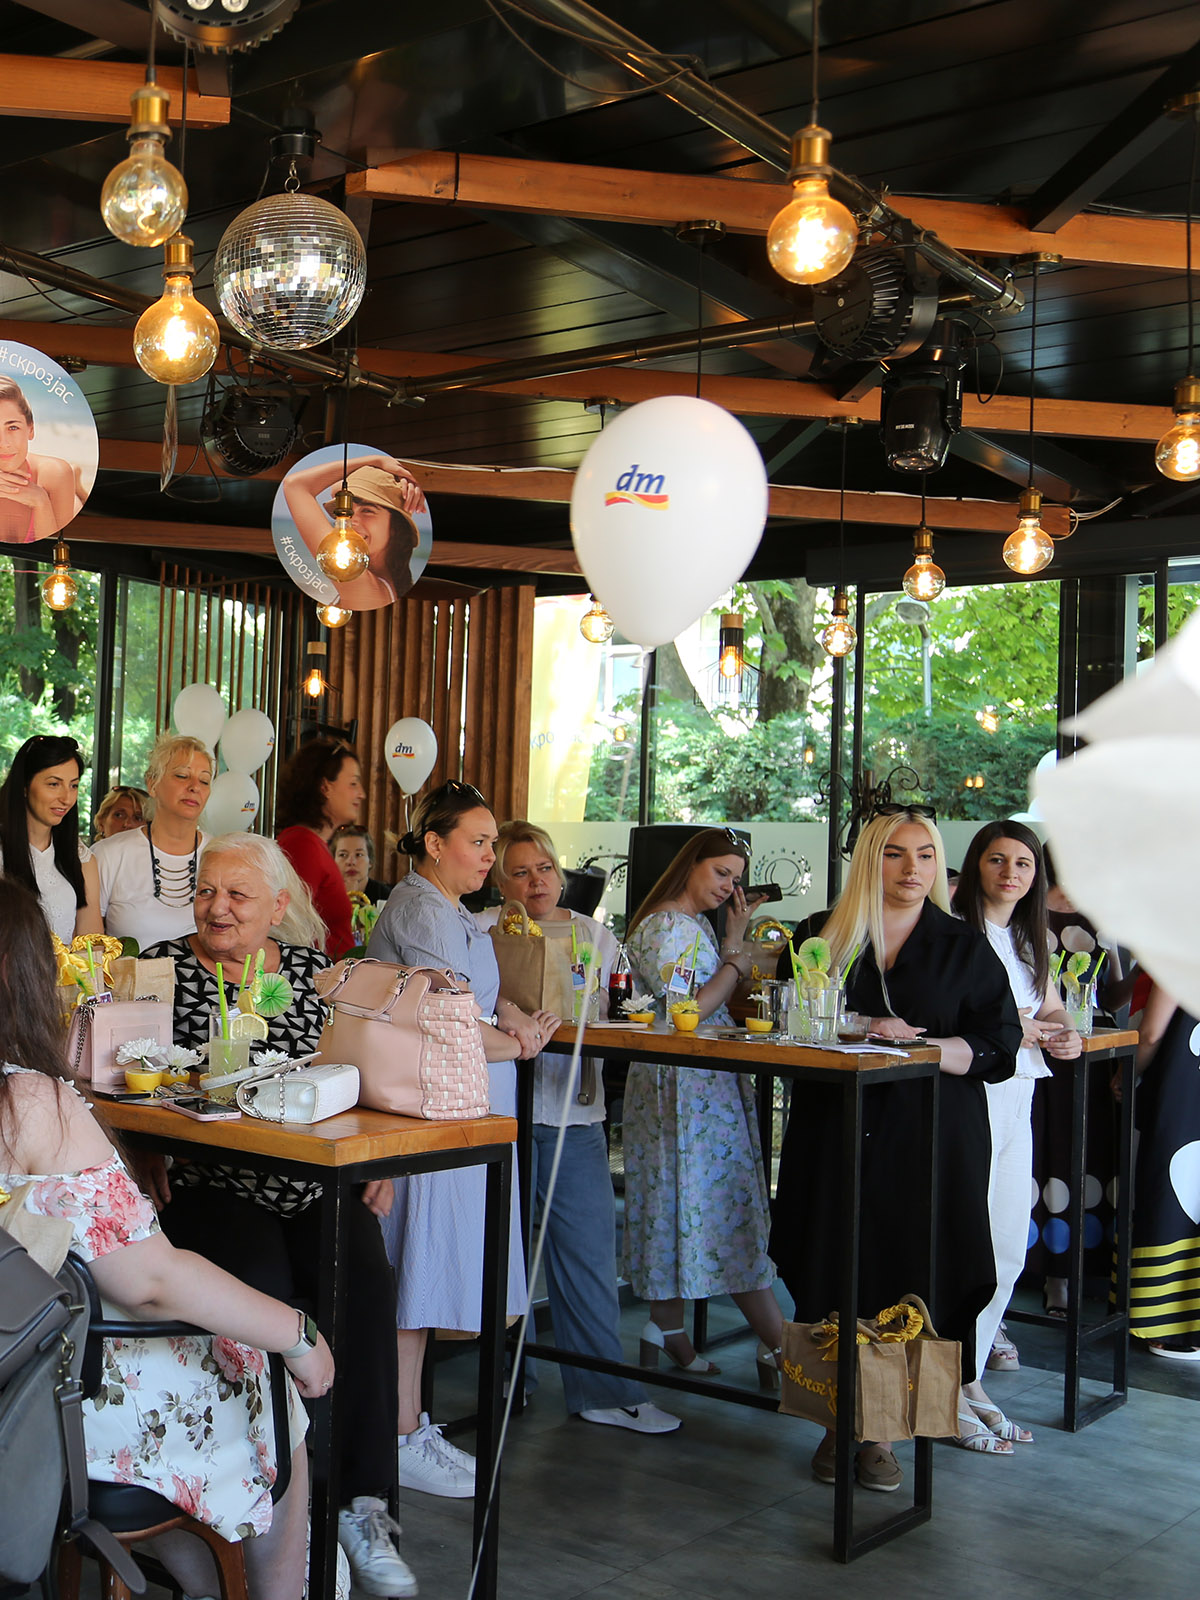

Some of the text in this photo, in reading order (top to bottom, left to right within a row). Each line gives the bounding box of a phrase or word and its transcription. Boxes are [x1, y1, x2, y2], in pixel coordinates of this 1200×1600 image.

[616, 464, 666, 494] dm
[280, 536, 329, 594] #скрозјас
[395, 742, 413, 754] dm
